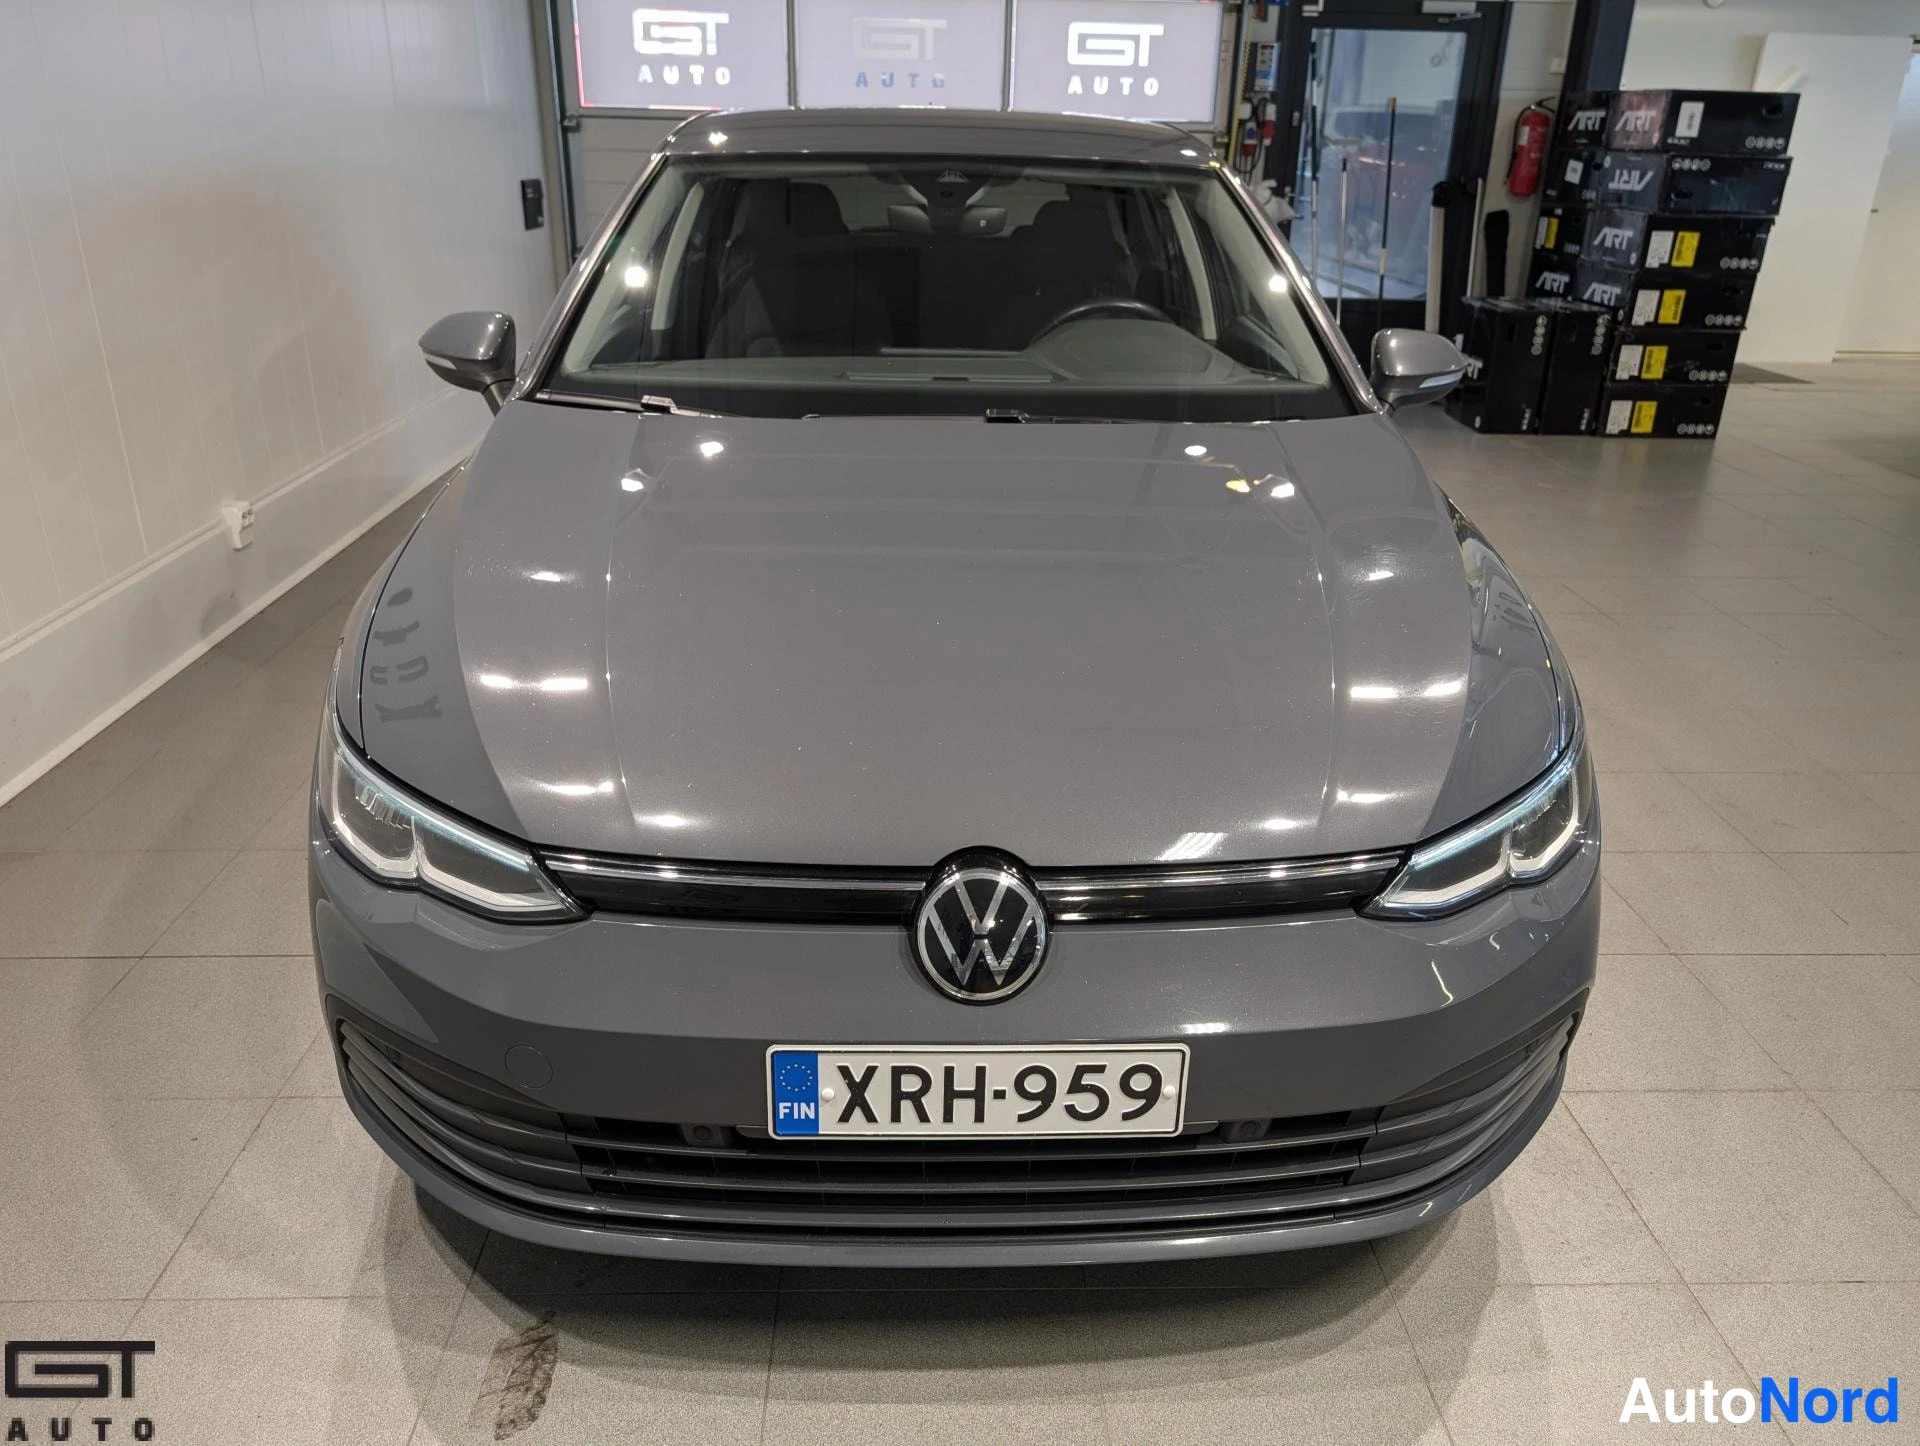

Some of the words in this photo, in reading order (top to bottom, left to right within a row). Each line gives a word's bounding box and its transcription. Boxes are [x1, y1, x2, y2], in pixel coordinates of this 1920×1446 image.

[638, 64, 731, 85] AUTO
[855, 71, 945, 88] AUTO
[1067, 75, 1159, 96] AUTO
[1567, 110, 1606, 131] ART
[1614, 110, 1656, 132] ART
[1593, 226, 1634, 250] ART
[1535, 271, 1570, 294] ART
[1582, 282, 1622, 307] ART
[778, 1101, 816, 1120] FIN
[836, 1063, 1164, 1124] XRH-959
